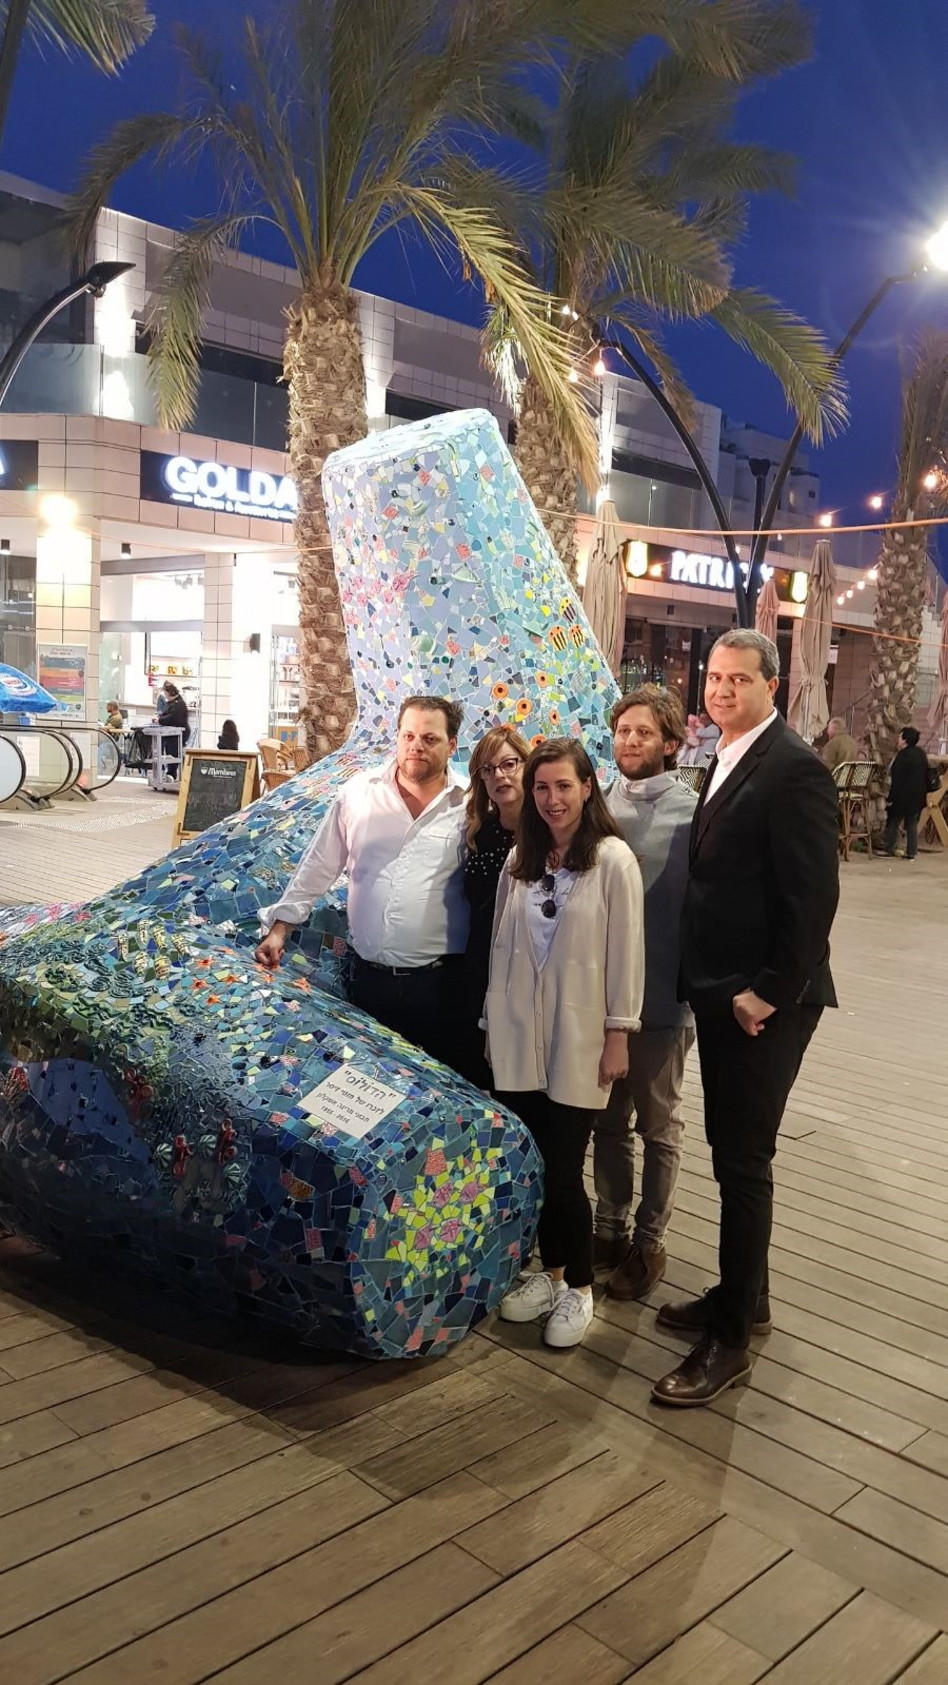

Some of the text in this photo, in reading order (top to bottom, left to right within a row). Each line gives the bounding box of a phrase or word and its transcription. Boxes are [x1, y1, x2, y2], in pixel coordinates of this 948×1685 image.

[165, 456, 298, 511] GOLDA
[354, 1095, 367, 1106] של
[364, 1102, 385, 1115] לזכרו
